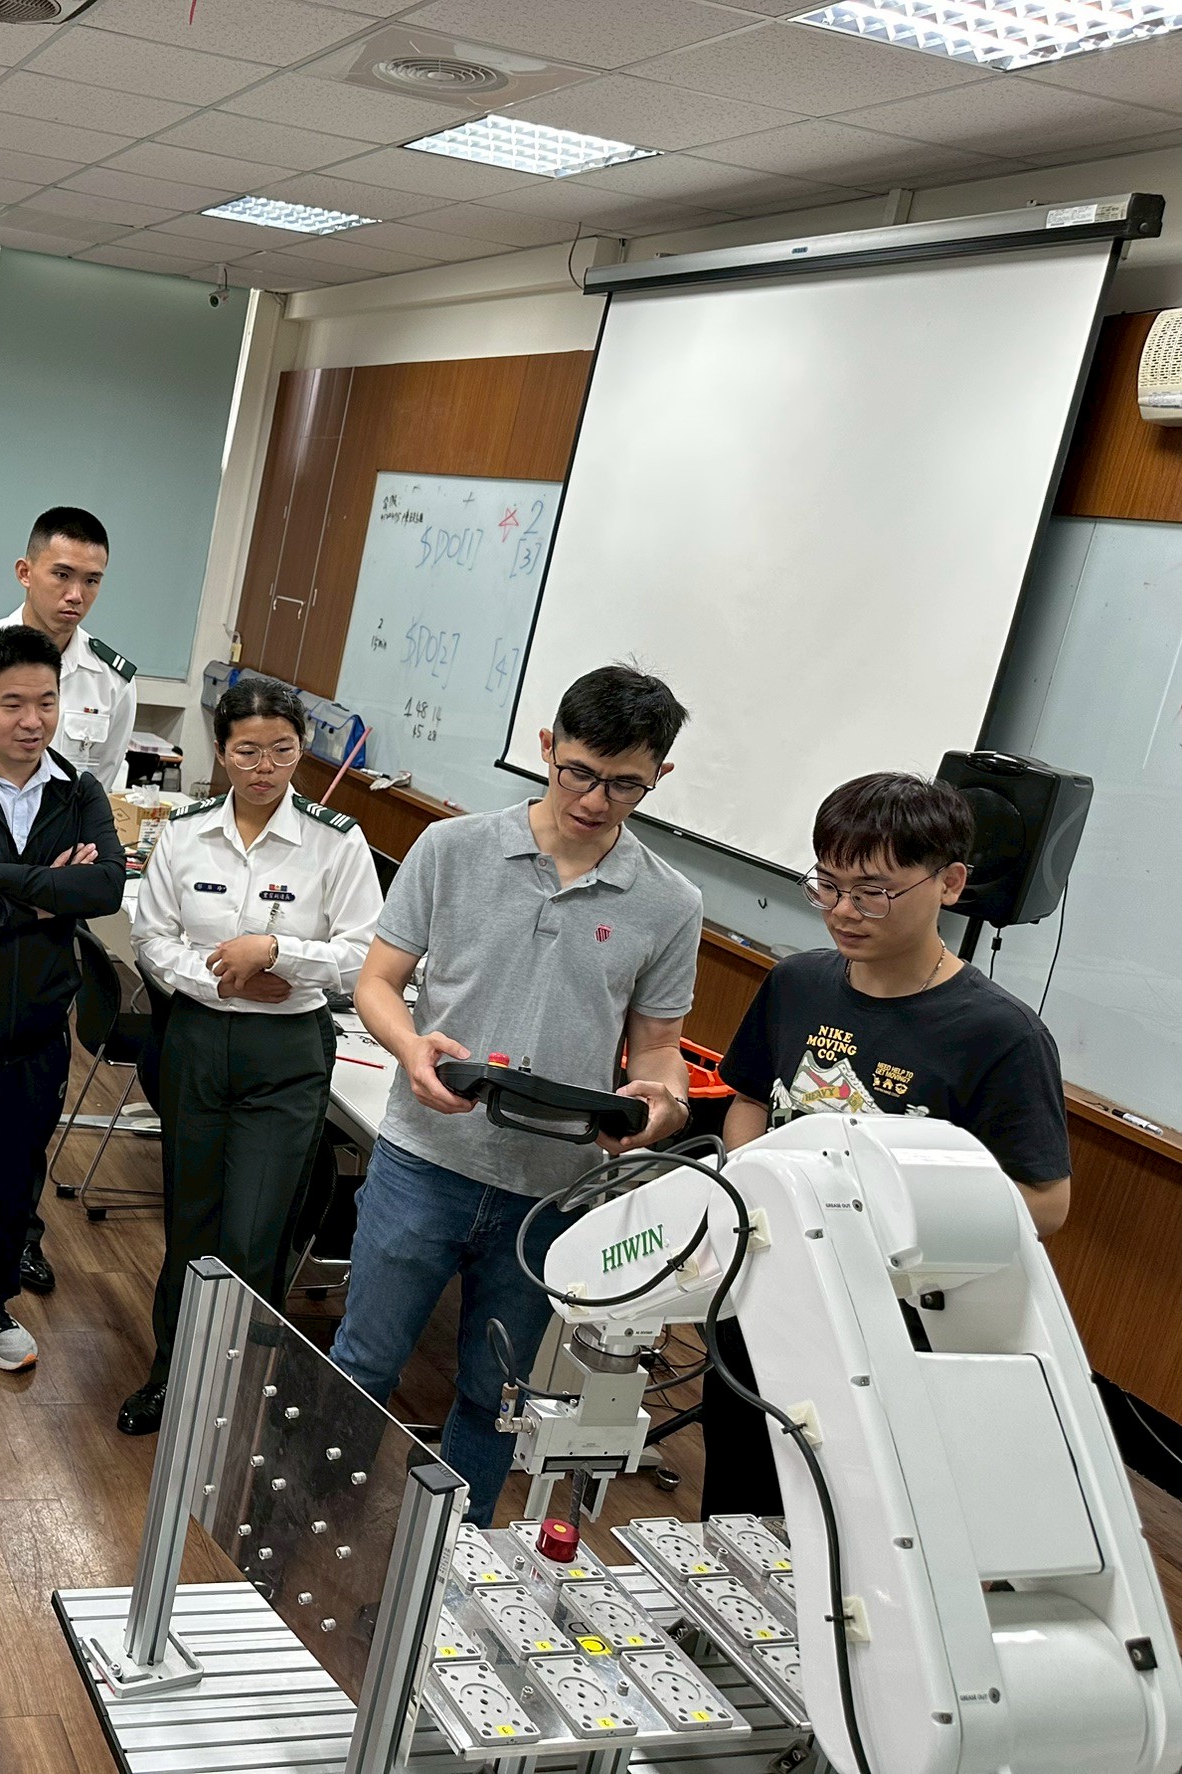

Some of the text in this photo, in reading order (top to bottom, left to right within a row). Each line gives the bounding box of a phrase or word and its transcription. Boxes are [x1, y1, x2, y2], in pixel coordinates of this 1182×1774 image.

[523, 499, 544, 535] 2
[818, 1025, 854, 1044] NIKE
[806, 1034, 858, 1056] MOVING
[817, 1048, 838, 1062] CO.
[906, 1070, 914, 1079] TO
[805, 1087, 836, 1101] HEAVY
[602, 1223, 665, 1275] HIWIN
[581, 1638, 606, 1653] C
